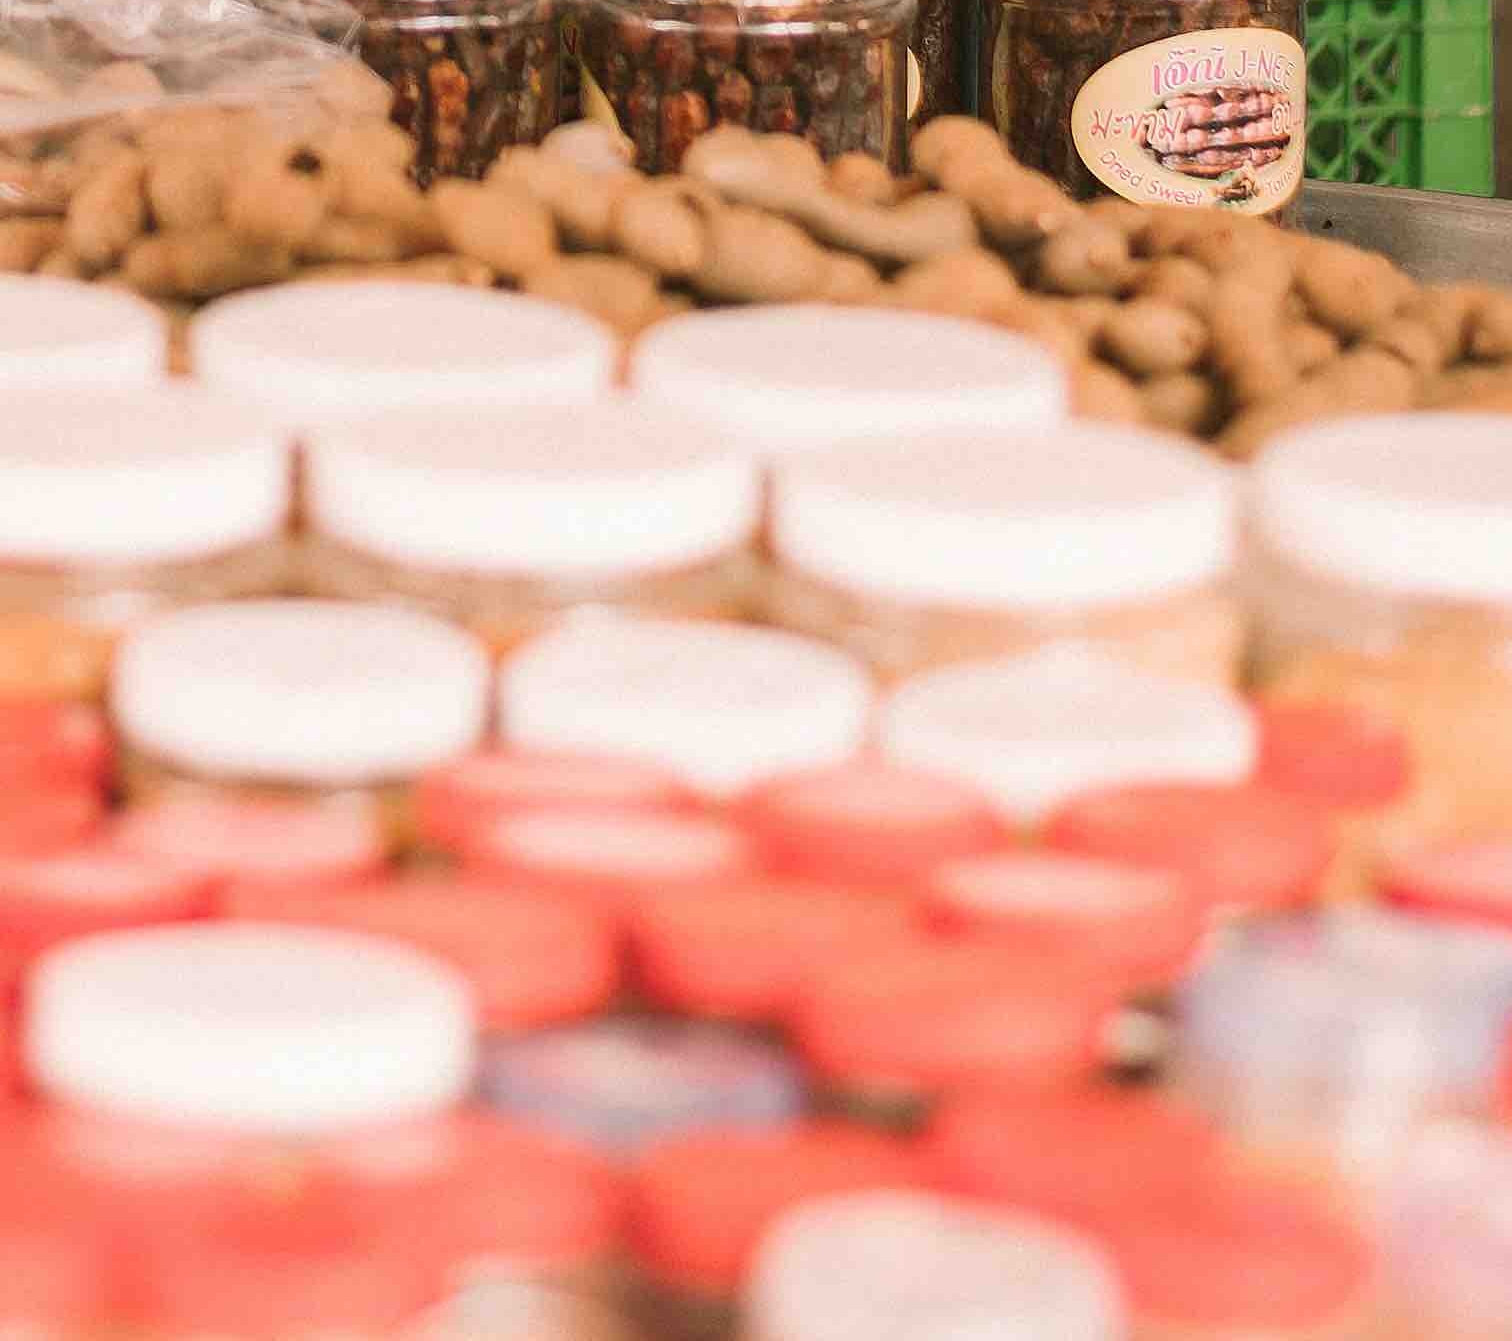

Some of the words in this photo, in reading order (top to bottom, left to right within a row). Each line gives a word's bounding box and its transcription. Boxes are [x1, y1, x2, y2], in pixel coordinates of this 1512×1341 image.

[1233, 48, 1297, 93] J-NEE
[1098, 148, 1145, 188] Dried
[1146, 179, 1206, 206] Sweet
